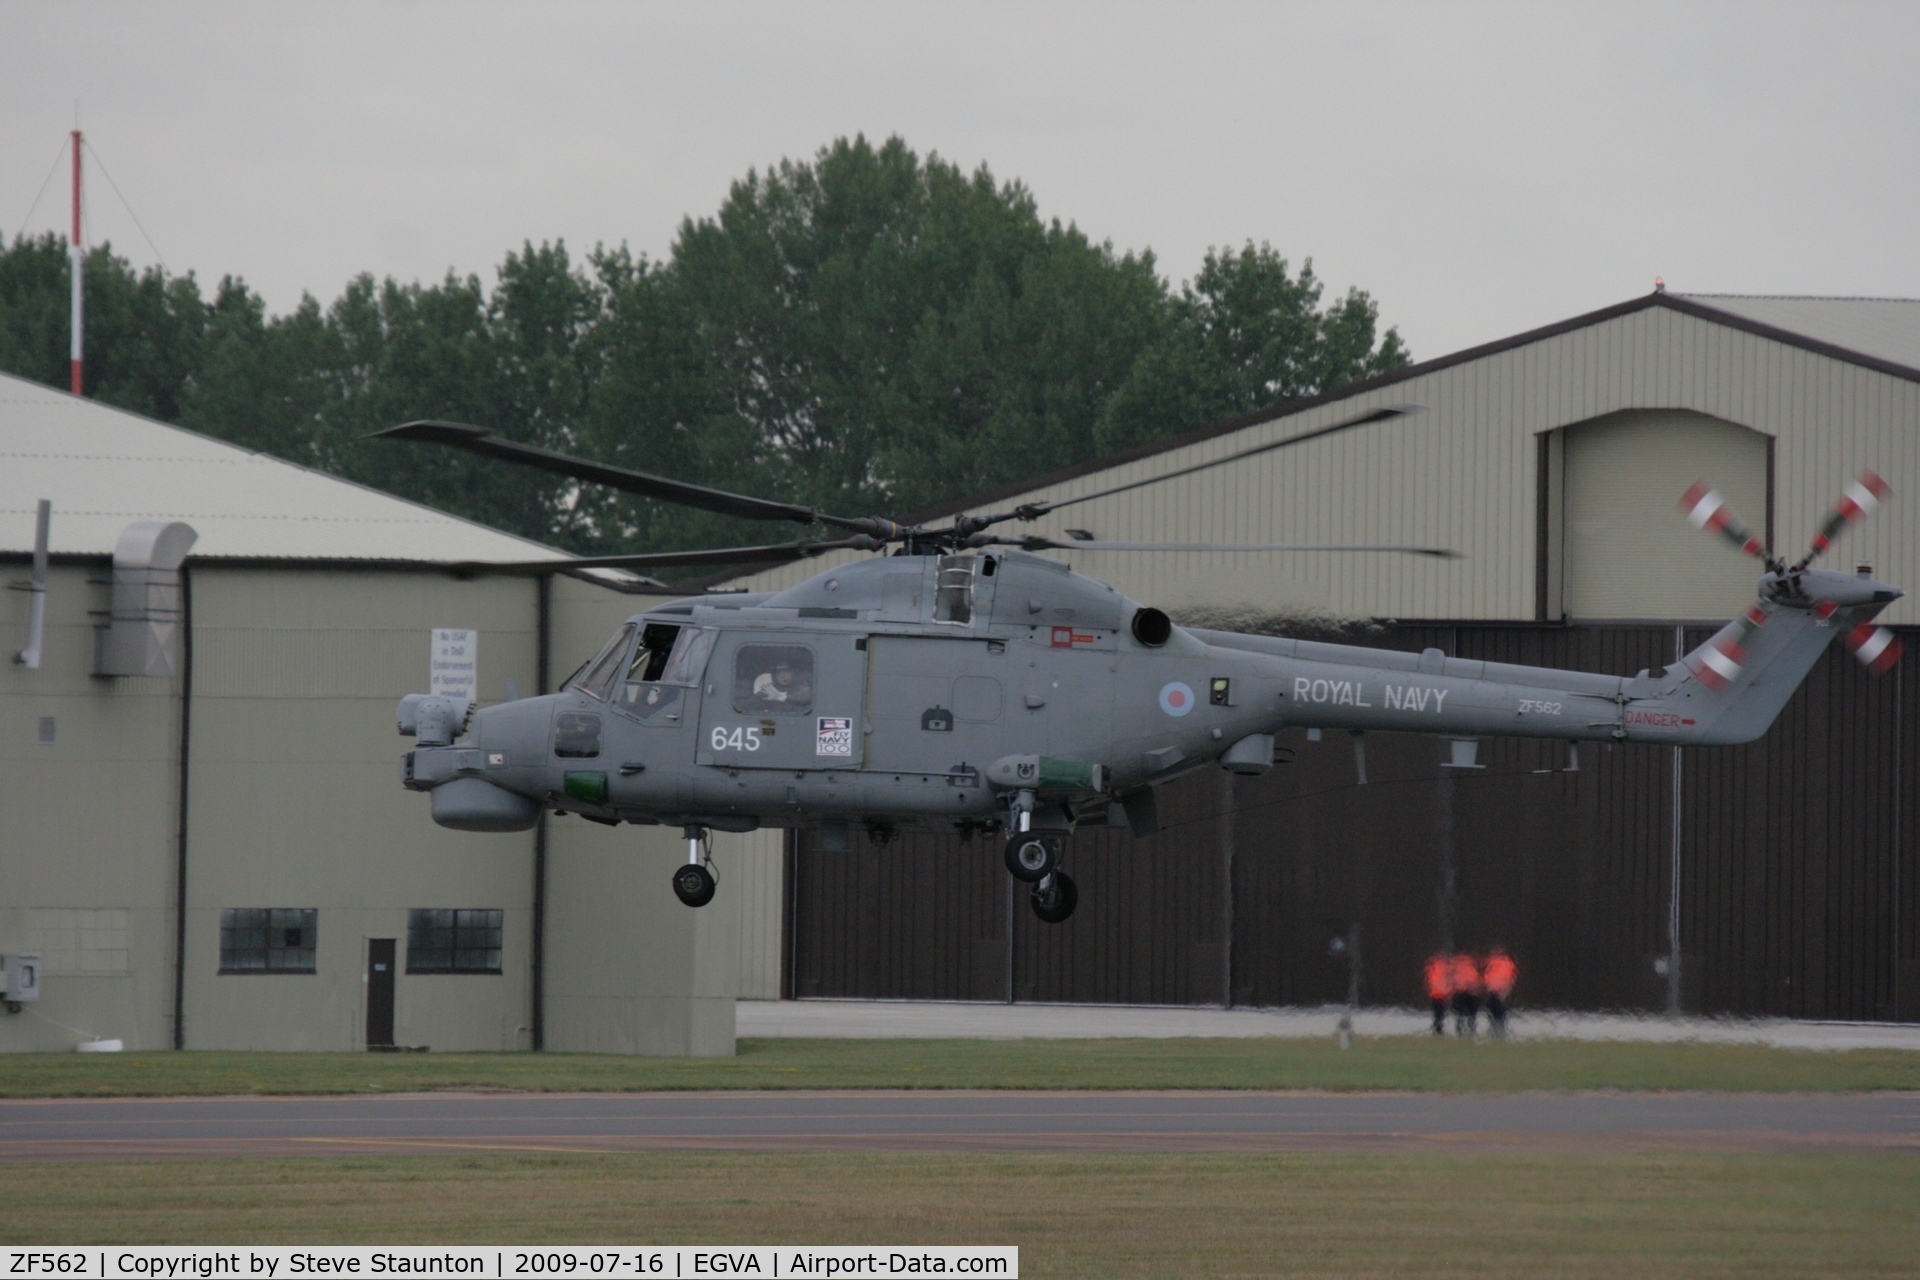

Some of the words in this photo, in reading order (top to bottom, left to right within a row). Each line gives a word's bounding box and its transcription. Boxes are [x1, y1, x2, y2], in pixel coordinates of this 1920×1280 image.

[440, 631, 450, 641] No
[452, 631, 468, 641] USAF
[451, 646, 464, 656] DoD
[433, 660, 473, 670] Endorsement
[432, 673, 440, 684] of
[1293, 677, 1372, 708] ROYAL
[1384, 685, 1448, 714] NAVY
[1518, 699, 1562, 715] ZF562
[1624, 710, 1680, 728] DANGER
[711, 726, 760, 751] 645
[818, 744, 850, 753] 100
